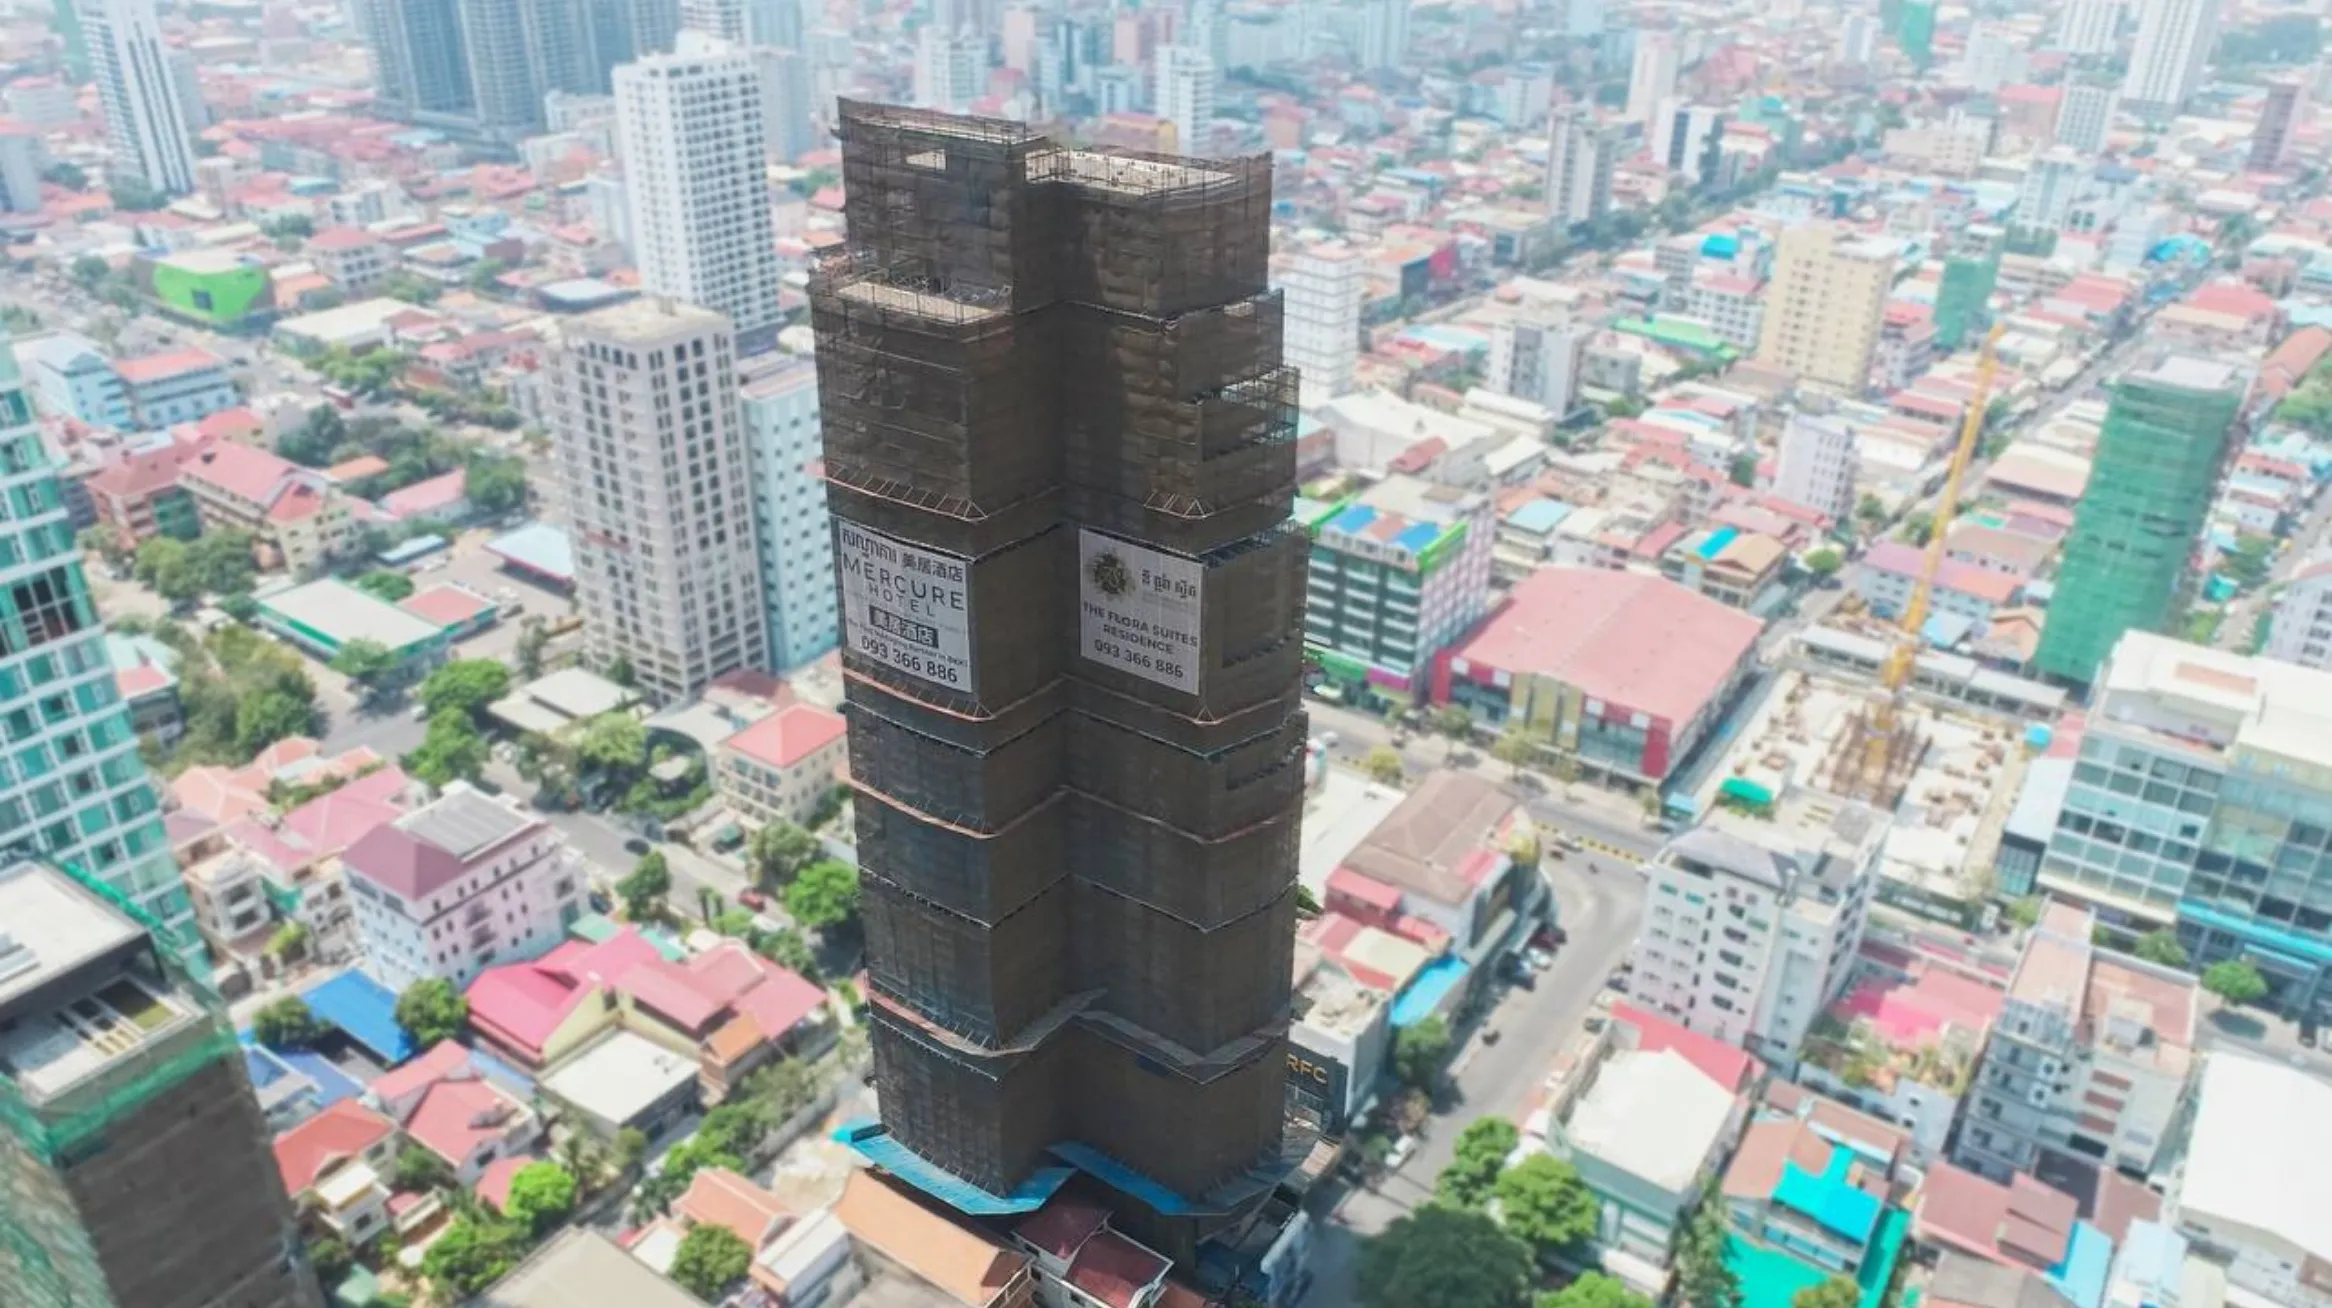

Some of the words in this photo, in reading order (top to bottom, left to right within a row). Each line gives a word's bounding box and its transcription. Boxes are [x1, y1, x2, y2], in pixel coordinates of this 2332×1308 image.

[842, 552, 964, 611] MERCURE
[868, 582, 936, 618] HOTEL
[1083, 601, 1105, 618] THE
[1108, 611, 1149, 632] FLORA
[1152, 624, 1198, 647] SUITES
[1103, 624, 1174, 655] RESIDENCE
[861, 635, 888, 659] 093
[893, 648, 921, 671] 366
[926, 660, 958, 683] 886
[1094, 639, 1120, 658] 093
[1124, 649, 1151, 668] 366
[1156, 659, 1184, 678] 886
